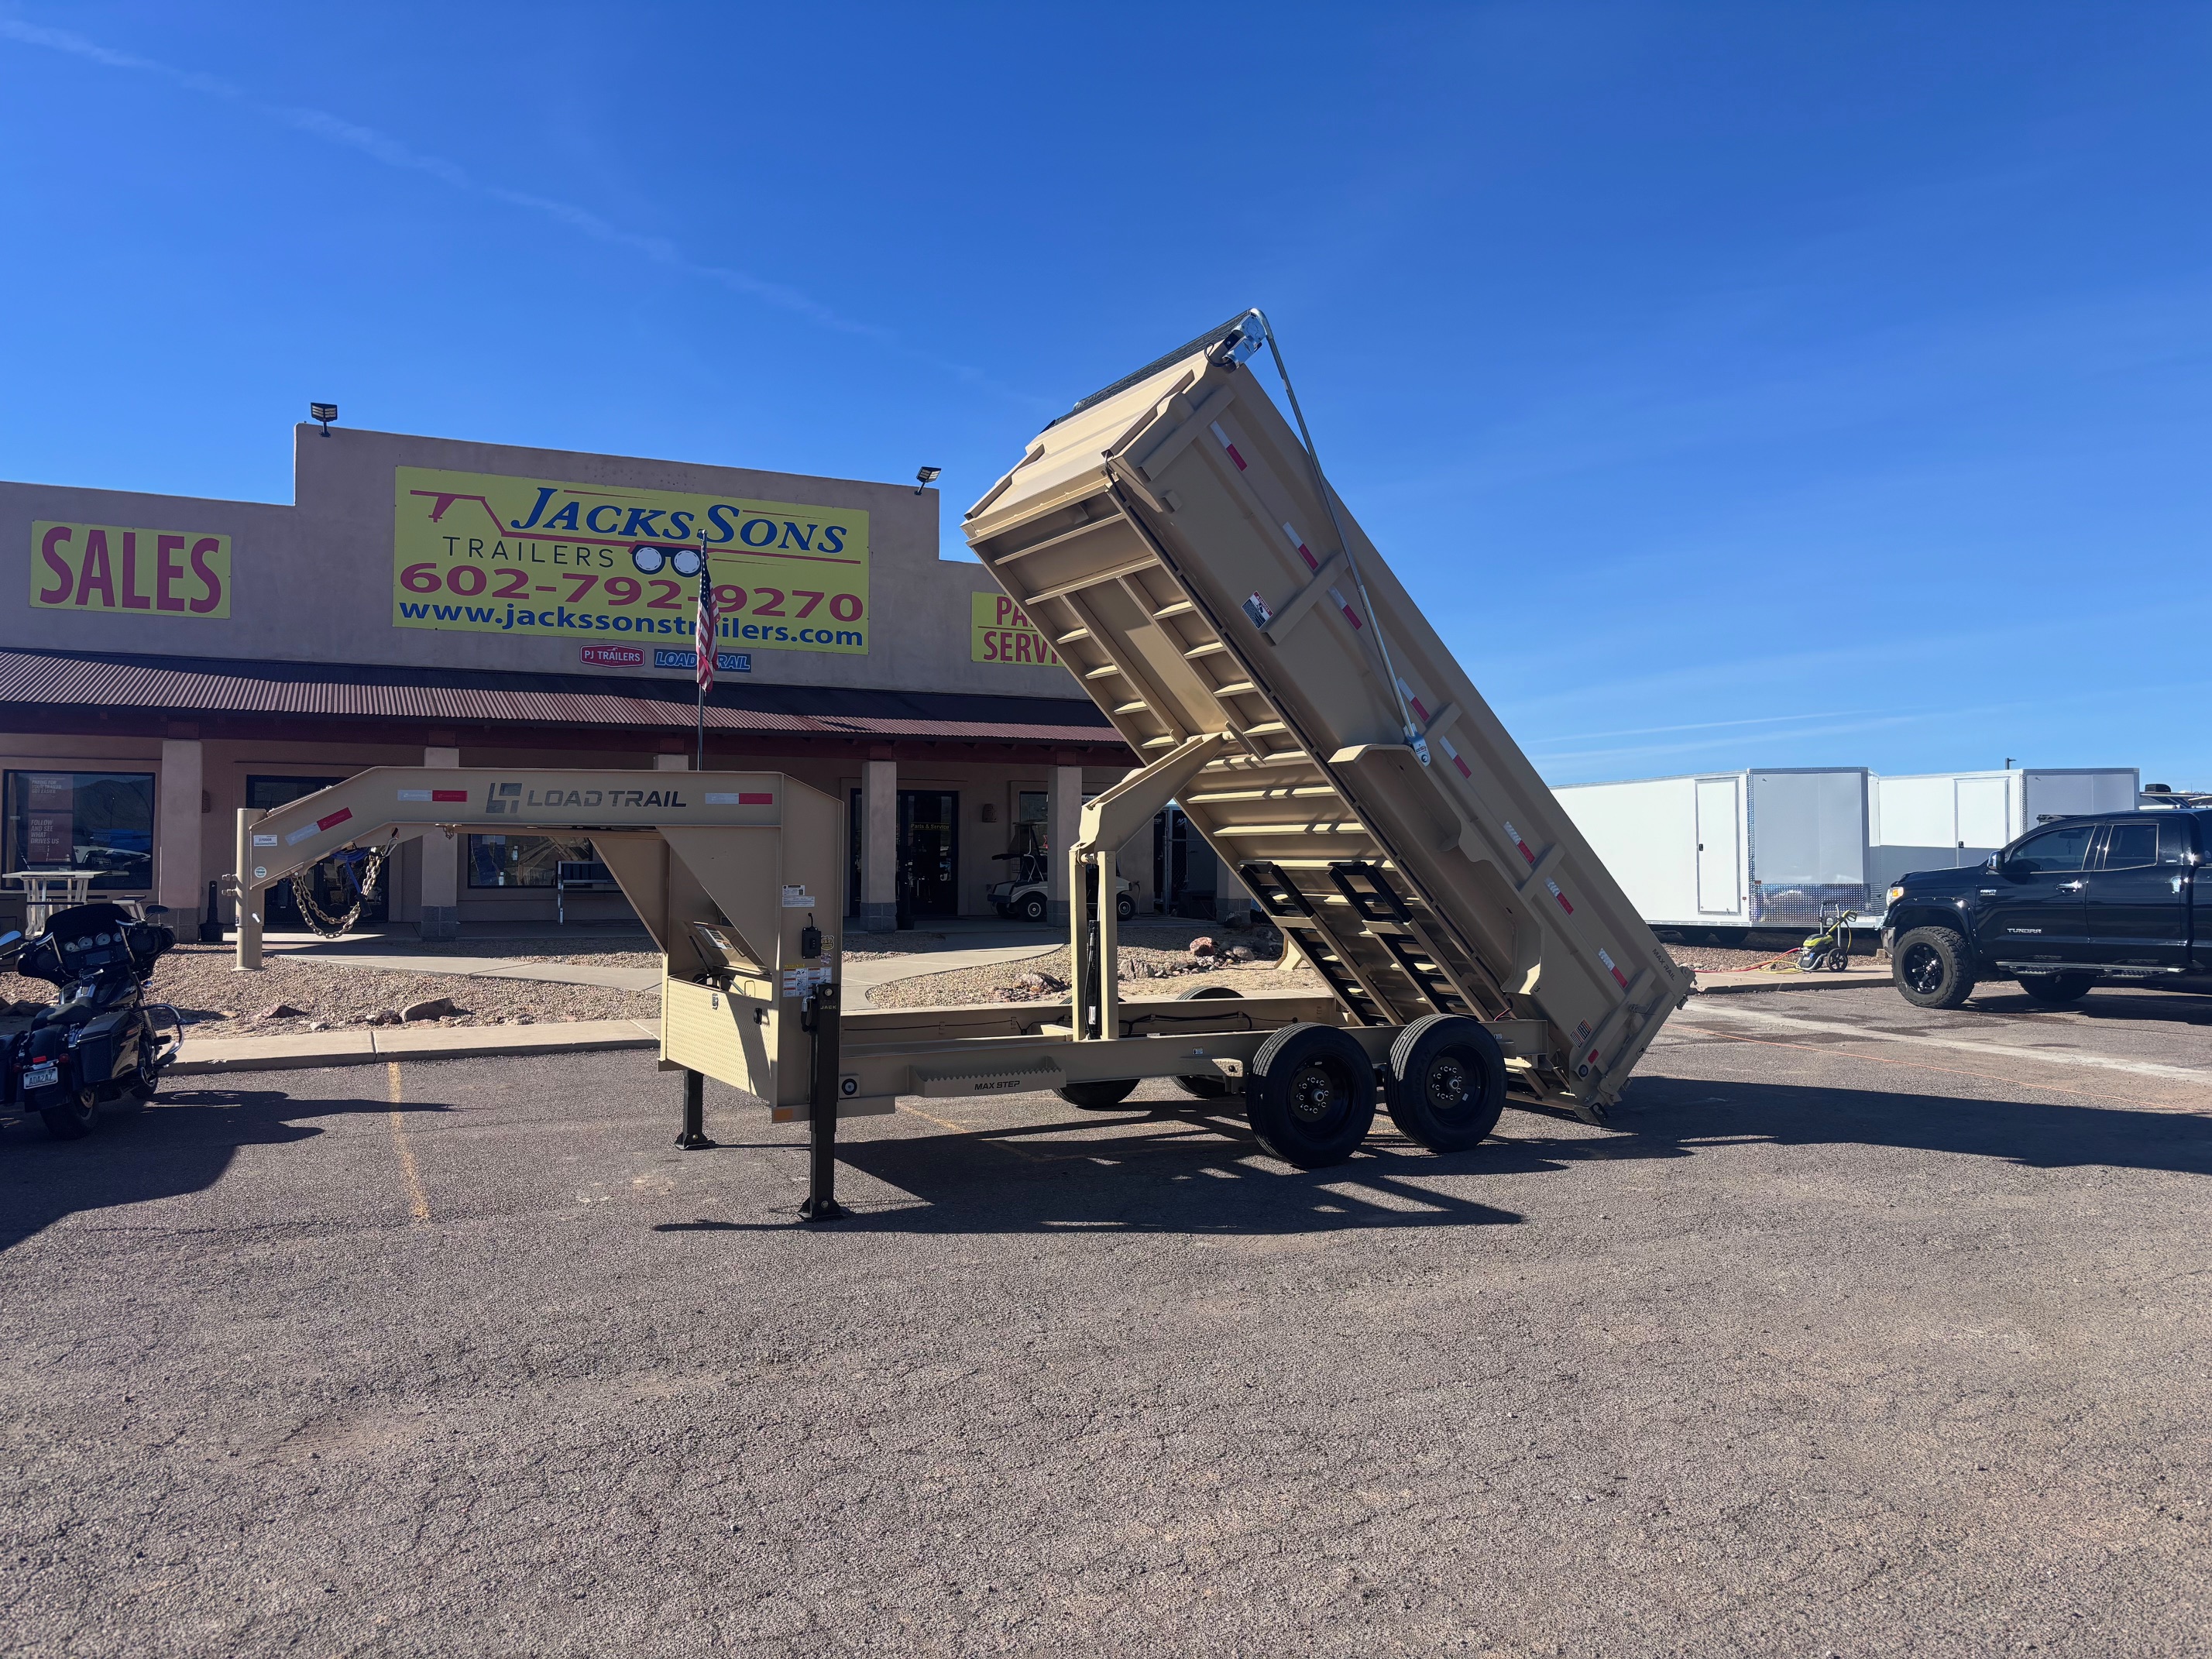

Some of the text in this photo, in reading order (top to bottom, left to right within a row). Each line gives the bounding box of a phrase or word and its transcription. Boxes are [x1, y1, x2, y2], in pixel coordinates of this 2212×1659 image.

[442, 536, 615, 568] TRAILERS
[39, 526, 222, 613] SALES
[400, 562, 864, 623] 602-792-9270
[399, 601, 864, 646] www.jackssonstrilers.com
[997, 596, 1033, 627] PA
[584, 650, 641, 662] PJ TRAILERS
[655, 651, 750, 670] LOAD RAIL
[527, 790, 688, 808] LOAD TRAIL
[1652, 948, 1675, 981] MAX RAIL
[974, 1082, 994, 1091] MAX
